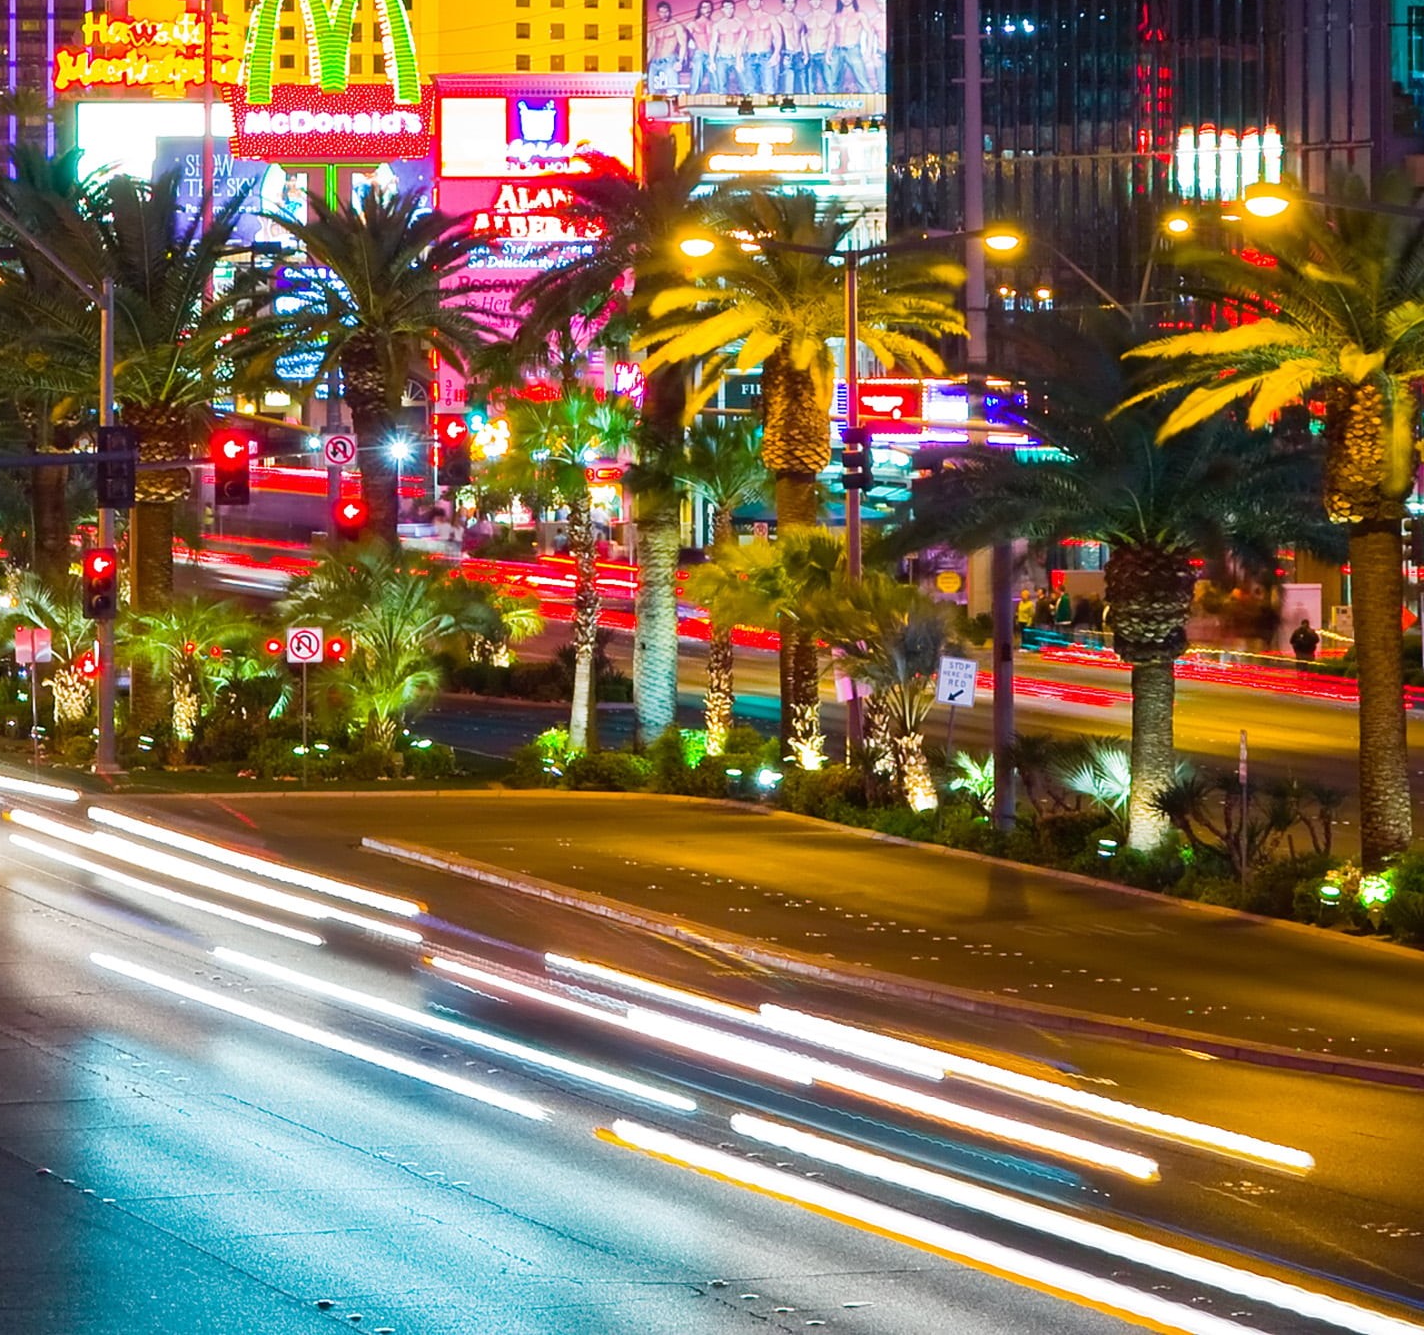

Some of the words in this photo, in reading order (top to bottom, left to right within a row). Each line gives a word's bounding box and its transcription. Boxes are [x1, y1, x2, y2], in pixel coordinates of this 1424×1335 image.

[244, 109, 423, 134] McDonald's
[949, 661, 971, 671] STOP
[948, 678, 967, 688] RED
